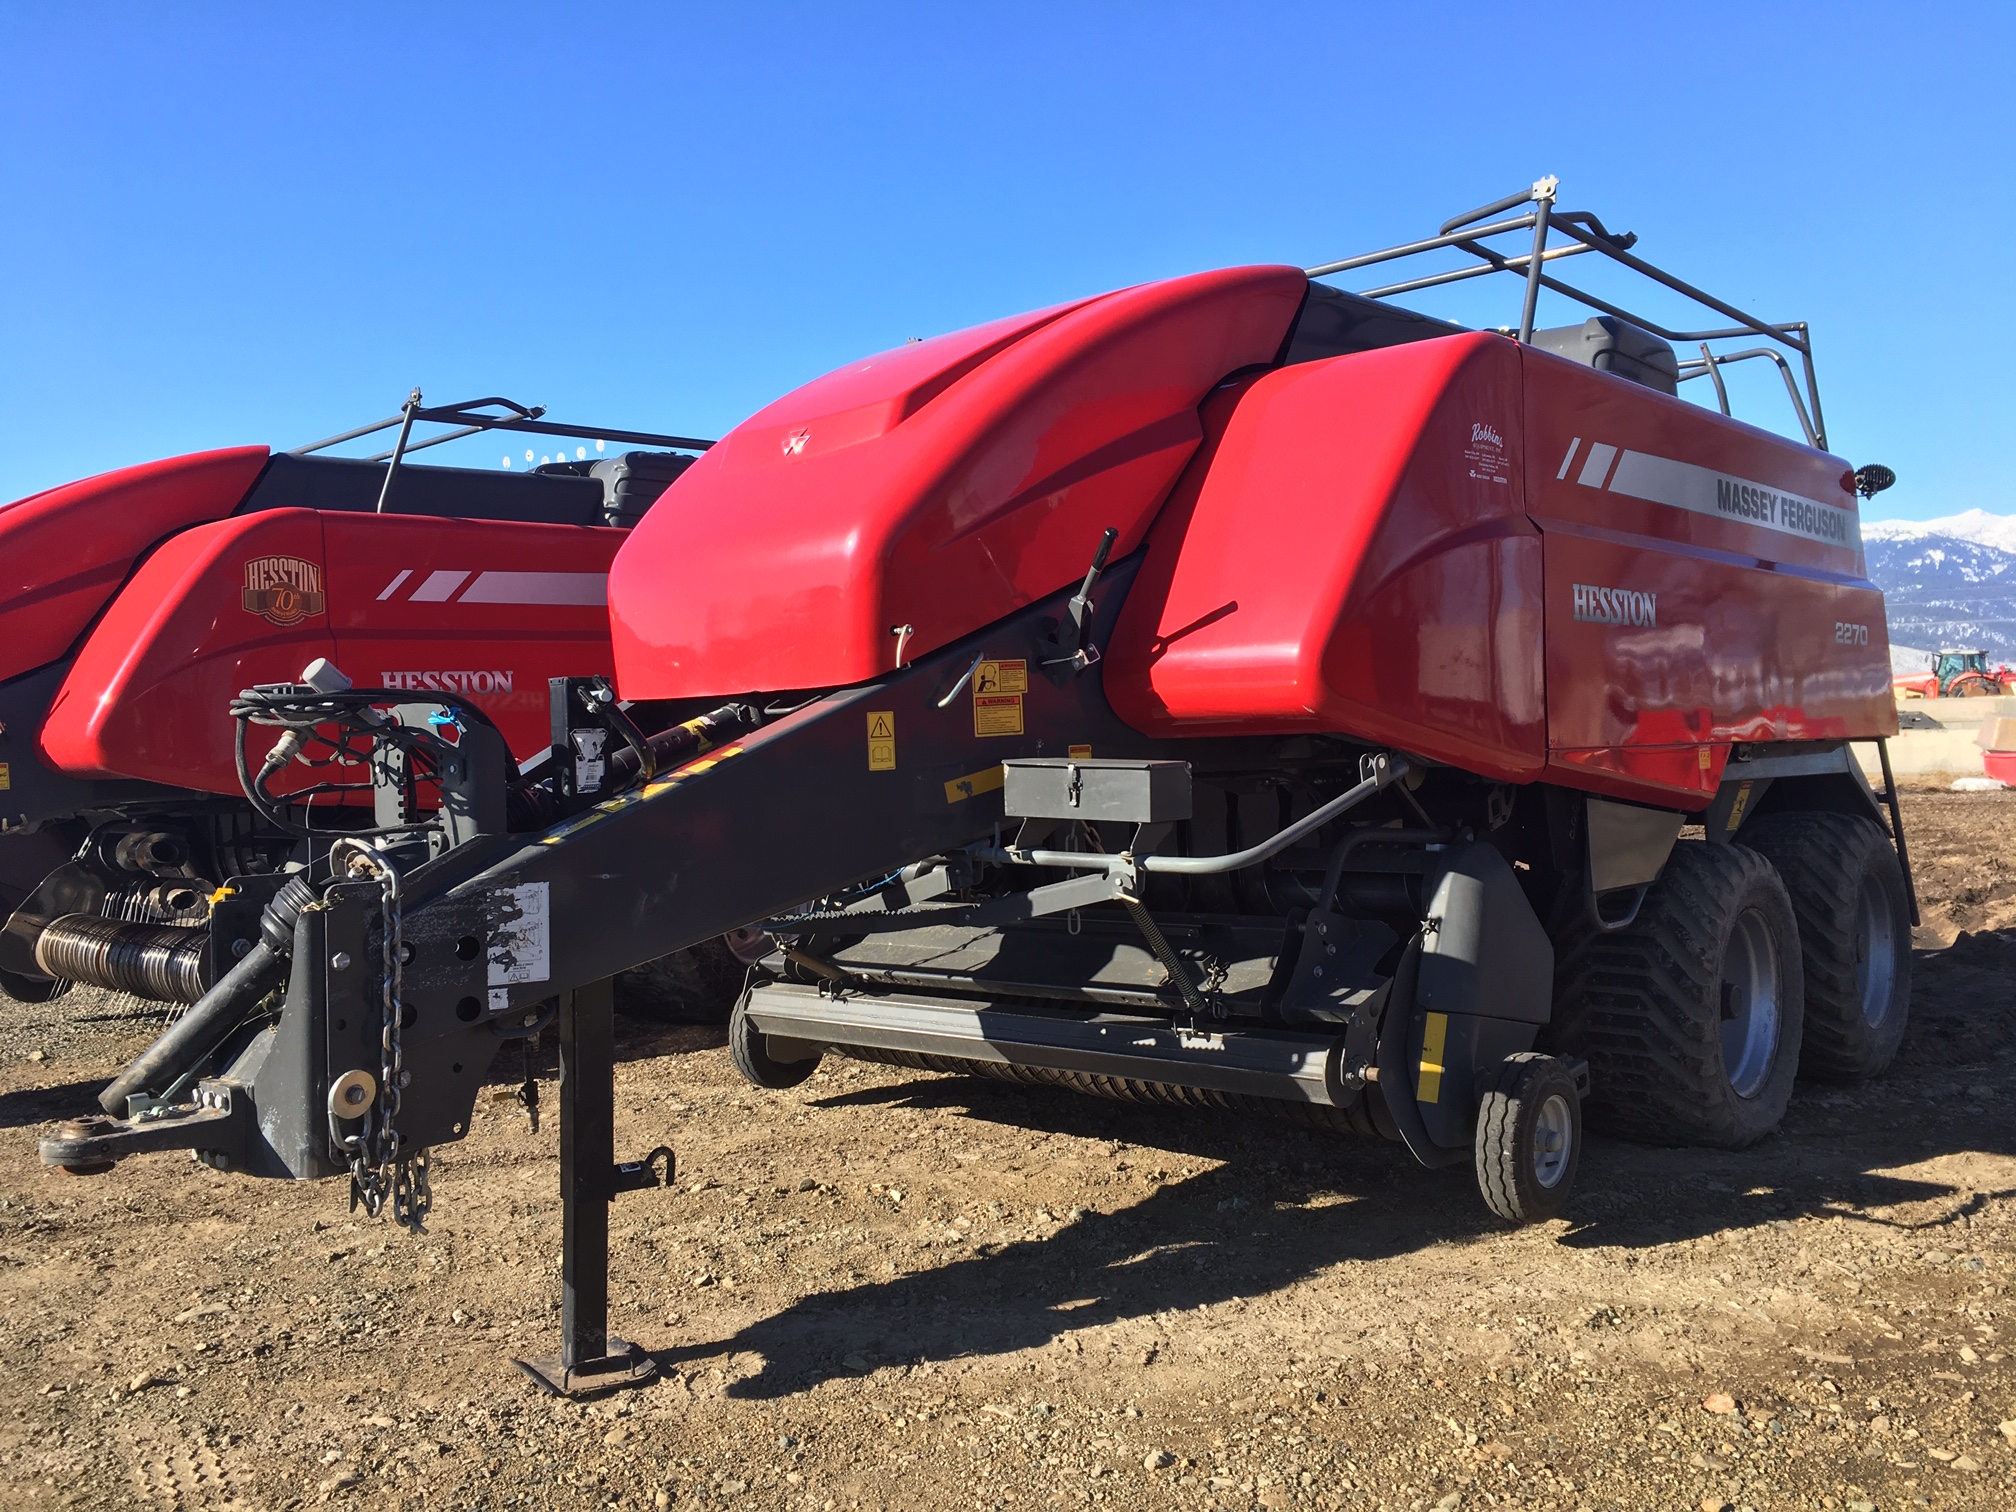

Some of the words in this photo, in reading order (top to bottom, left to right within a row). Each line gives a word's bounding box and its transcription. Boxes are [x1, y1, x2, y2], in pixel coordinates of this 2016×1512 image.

[1472, 423, 1503, 448] Robbins
[1717, 479, 1778, 523] MASSEY
[1781, 497, 1846, 541] FERGUSON
[248, 557, 318, 593] HESSTON
[1572, 583, 1656, 628] HESSTON
[1836, 622, 1868, 646] 2270
[381, 670, 513, 695] HESSTON
[988, 697, 1015, 705] WARNING
